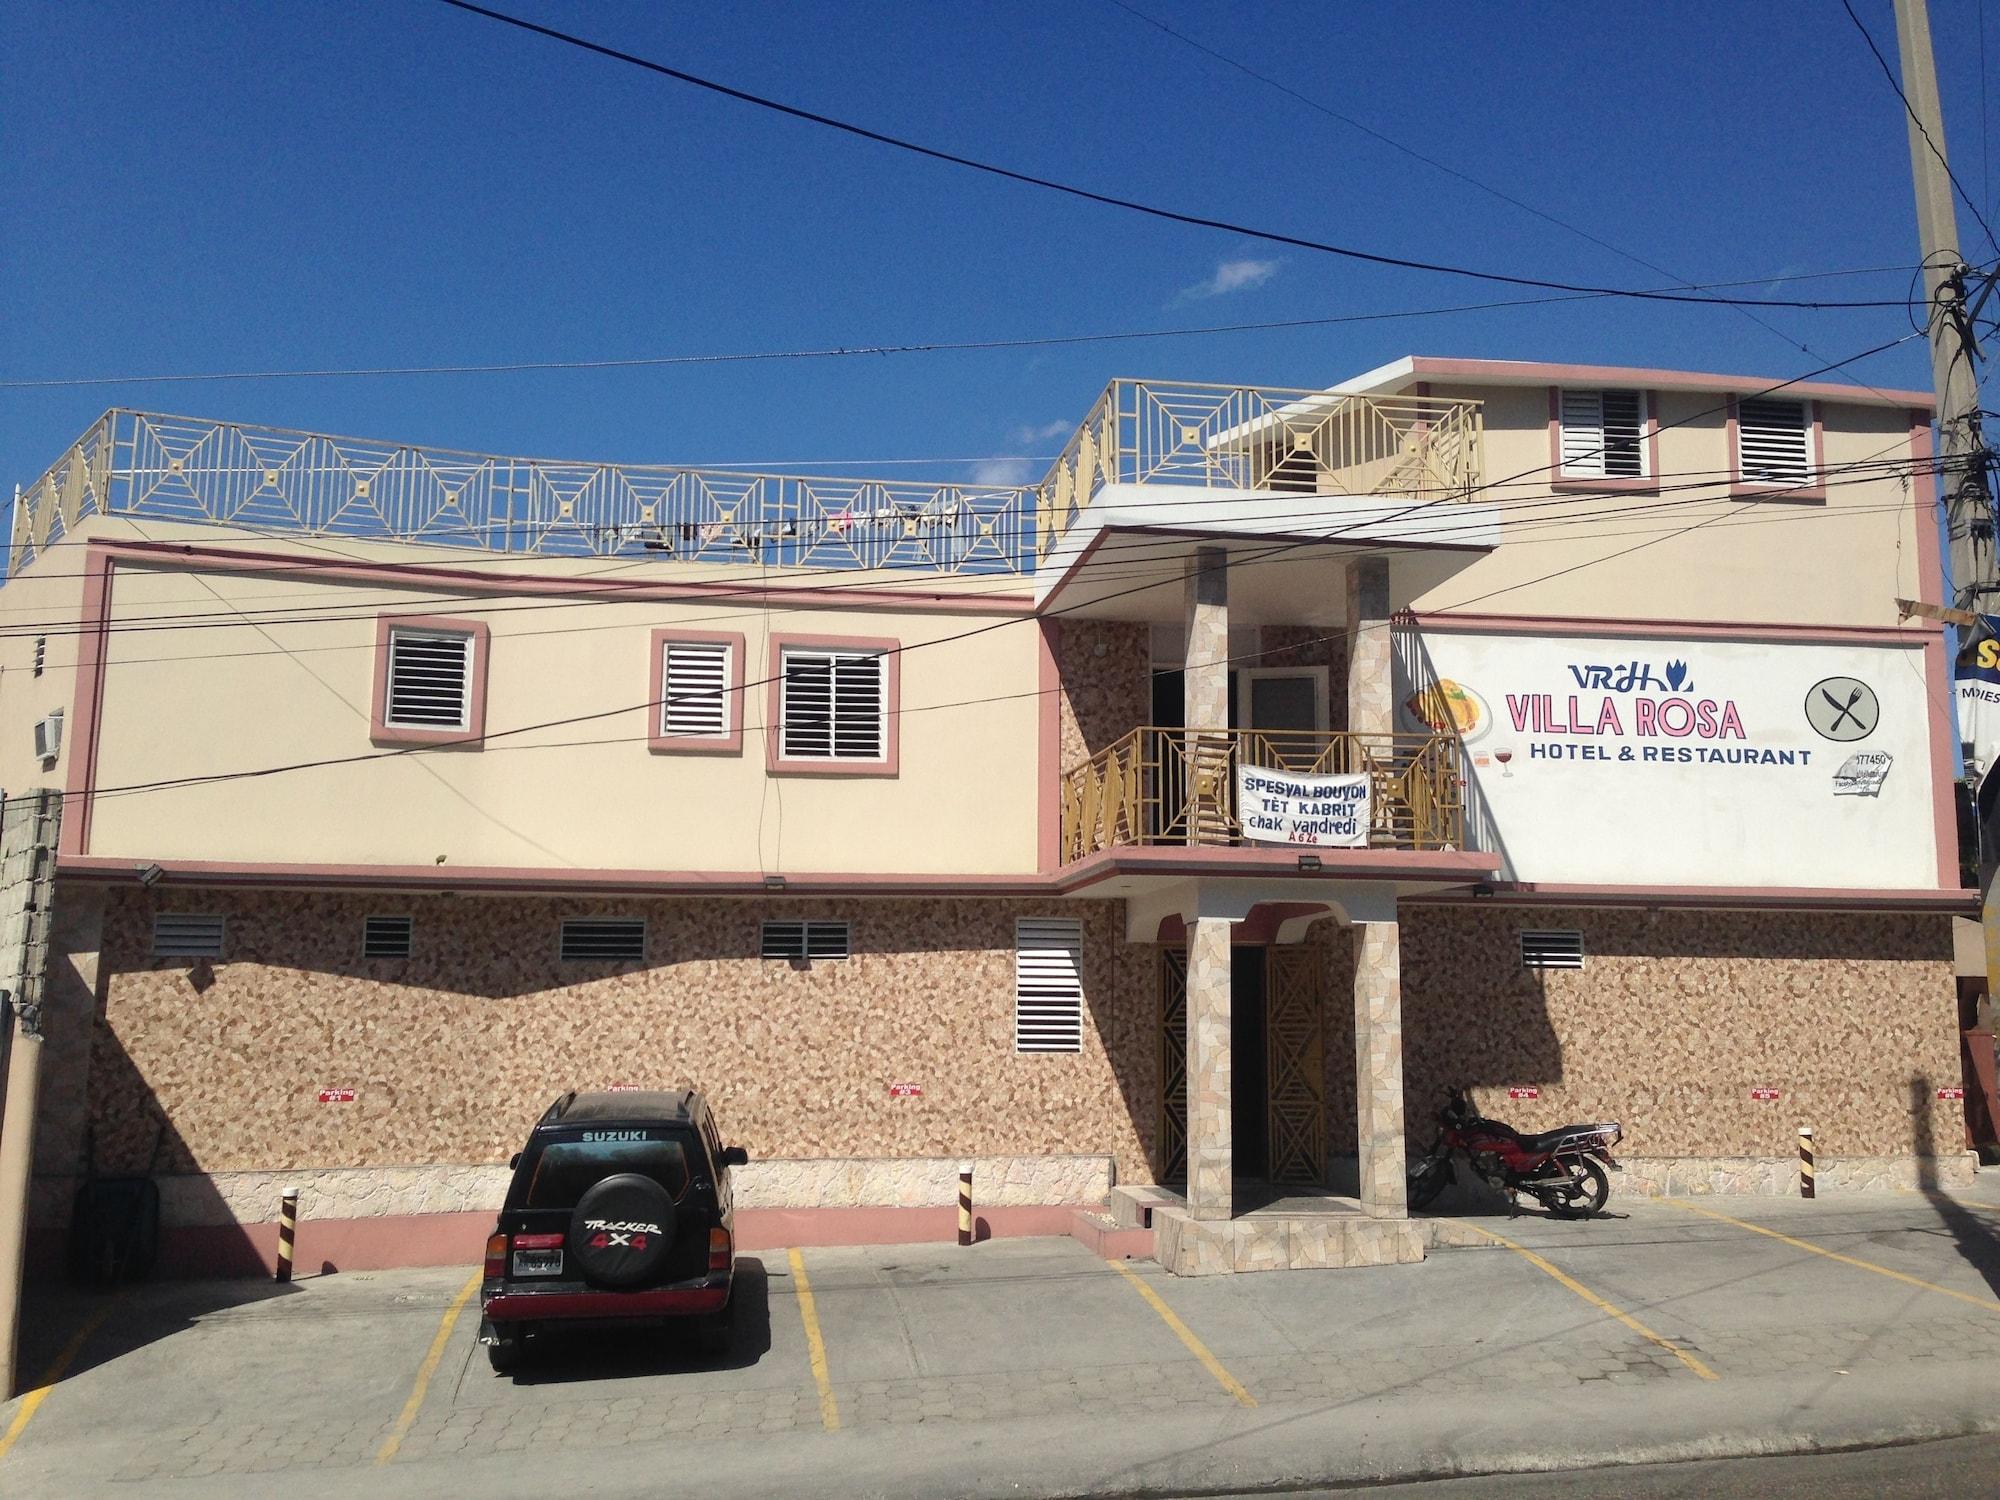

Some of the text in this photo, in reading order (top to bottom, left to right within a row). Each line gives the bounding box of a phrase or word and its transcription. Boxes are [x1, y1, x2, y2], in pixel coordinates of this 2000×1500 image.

[1506, 694, 1747, 739] VILLA ROSA
[1530, 743, 1811, 765] HOTEL & RESTAURANT
[1299, 801, 1356, 817] KABRIT
[1249, 815, 1357, 835] chak vandredi
[607, 1084, 640, 1092] Parking
[582, 1131, 647, 1142] SUZUKI
[584, 1220, 662, 1235] TRACKER
